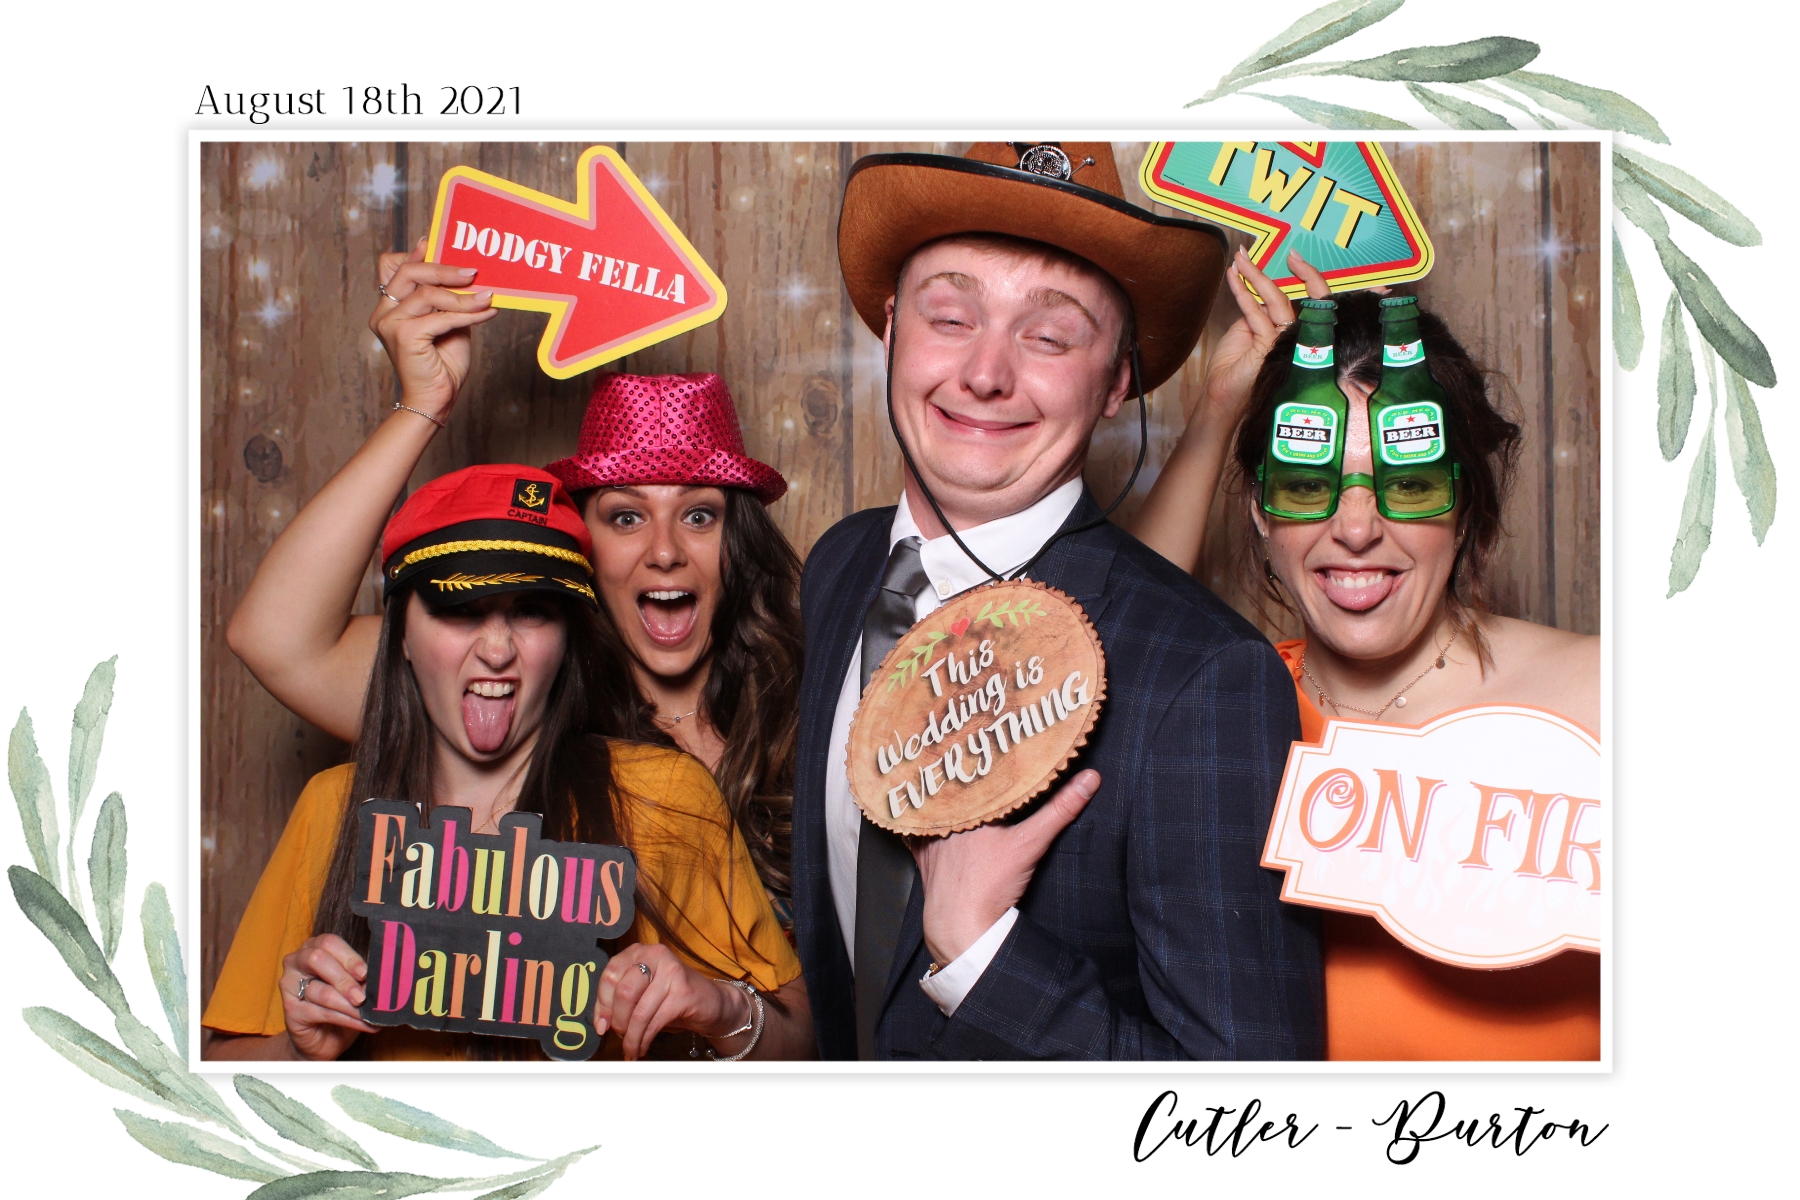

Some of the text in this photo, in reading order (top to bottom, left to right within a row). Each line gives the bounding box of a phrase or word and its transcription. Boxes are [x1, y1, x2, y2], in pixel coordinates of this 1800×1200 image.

[1207, 141, 1383, 250] TWIT
[451, 220, 686, 305] DODGY FELLA
[1392, 350, 1413, 358] BEER
[1278, 426, 1327, 441] BEER
[1385, 426, 1437, 442] BEER
[507, 508, 548, 526] CAPTAIN
[920, 638, 996, 697] This
[1015, 655, 1045, 689] is
[886, 670, 1095, 819] EVERYTHING
[1299, 767, 1601, 896] ON FIR
[362, 812, 625, 927] Fabulous
[372, 920, 596, 1051] Darling
